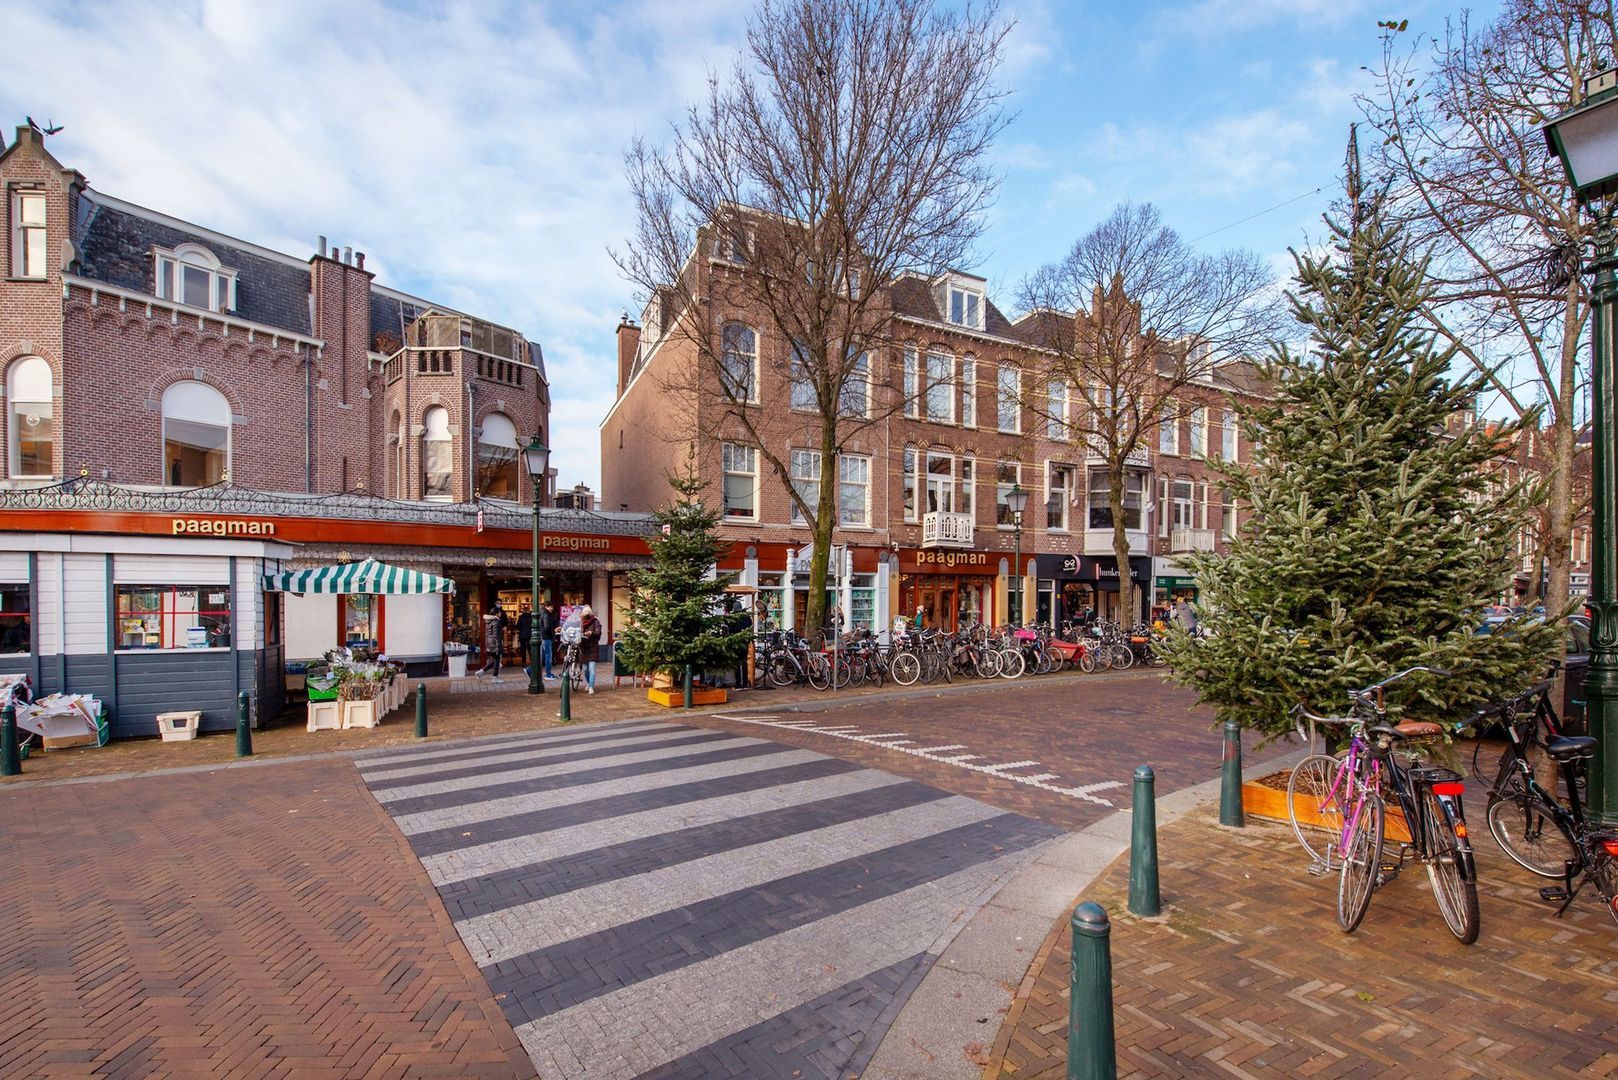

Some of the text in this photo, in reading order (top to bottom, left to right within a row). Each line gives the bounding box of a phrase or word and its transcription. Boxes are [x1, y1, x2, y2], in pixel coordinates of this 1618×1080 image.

[172, 519, 275, 536] paagman
[542, 535, 610, 550] paagman
[916, 551, 986, 567] paagman
